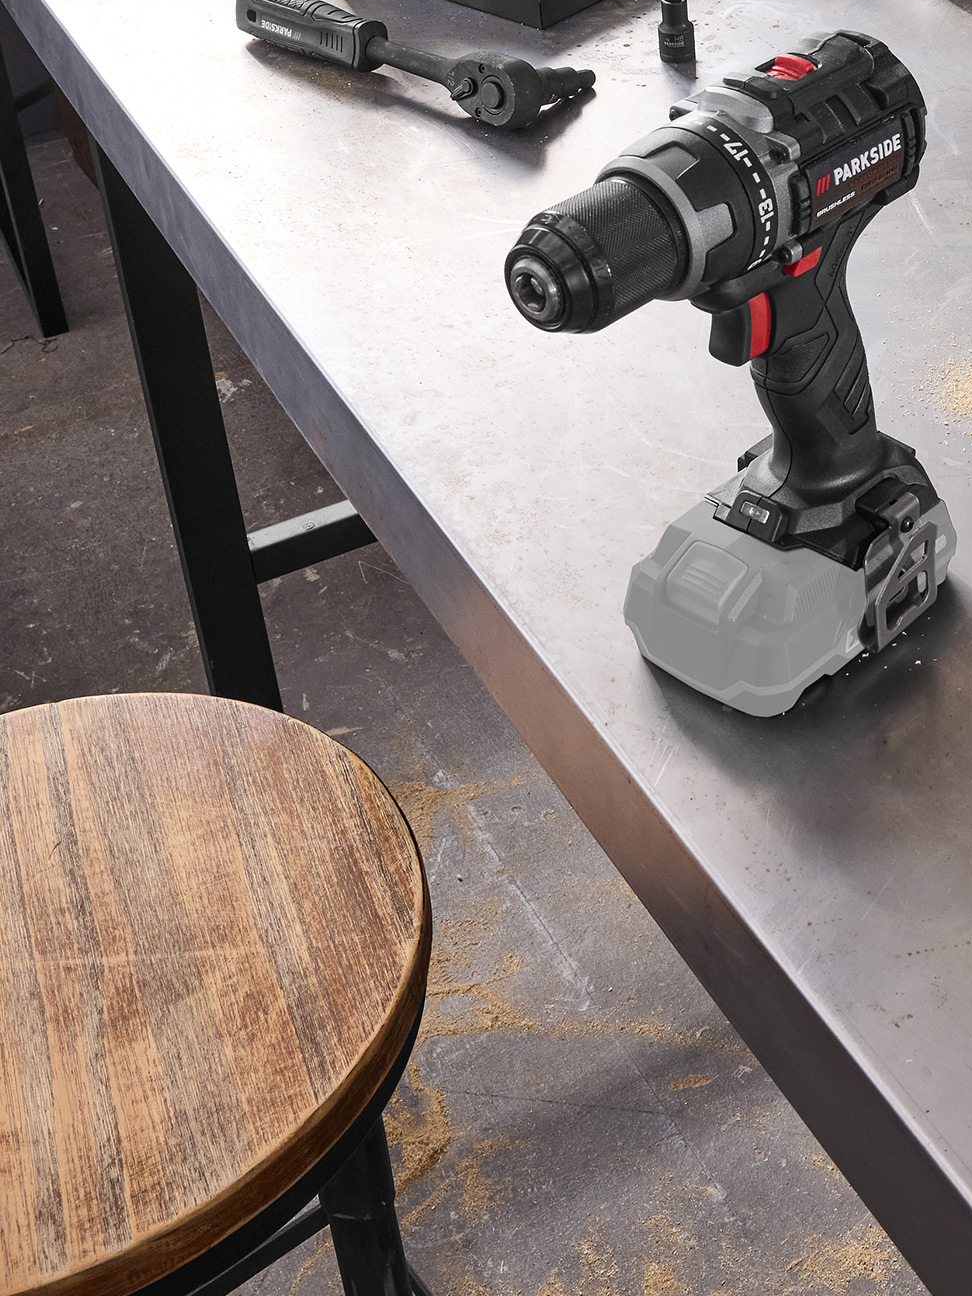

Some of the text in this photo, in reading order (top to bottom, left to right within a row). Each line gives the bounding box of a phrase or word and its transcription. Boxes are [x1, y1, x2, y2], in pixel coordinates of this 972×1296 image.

[261, 19, 292, 37] PARKSIDE
[723, 141, 749, 161] 17
[833, 133, 902, 185] PARKSIDE
[758, 198, 775, 223] 13
[816, 191, 855, 218] BRUSHLESS
